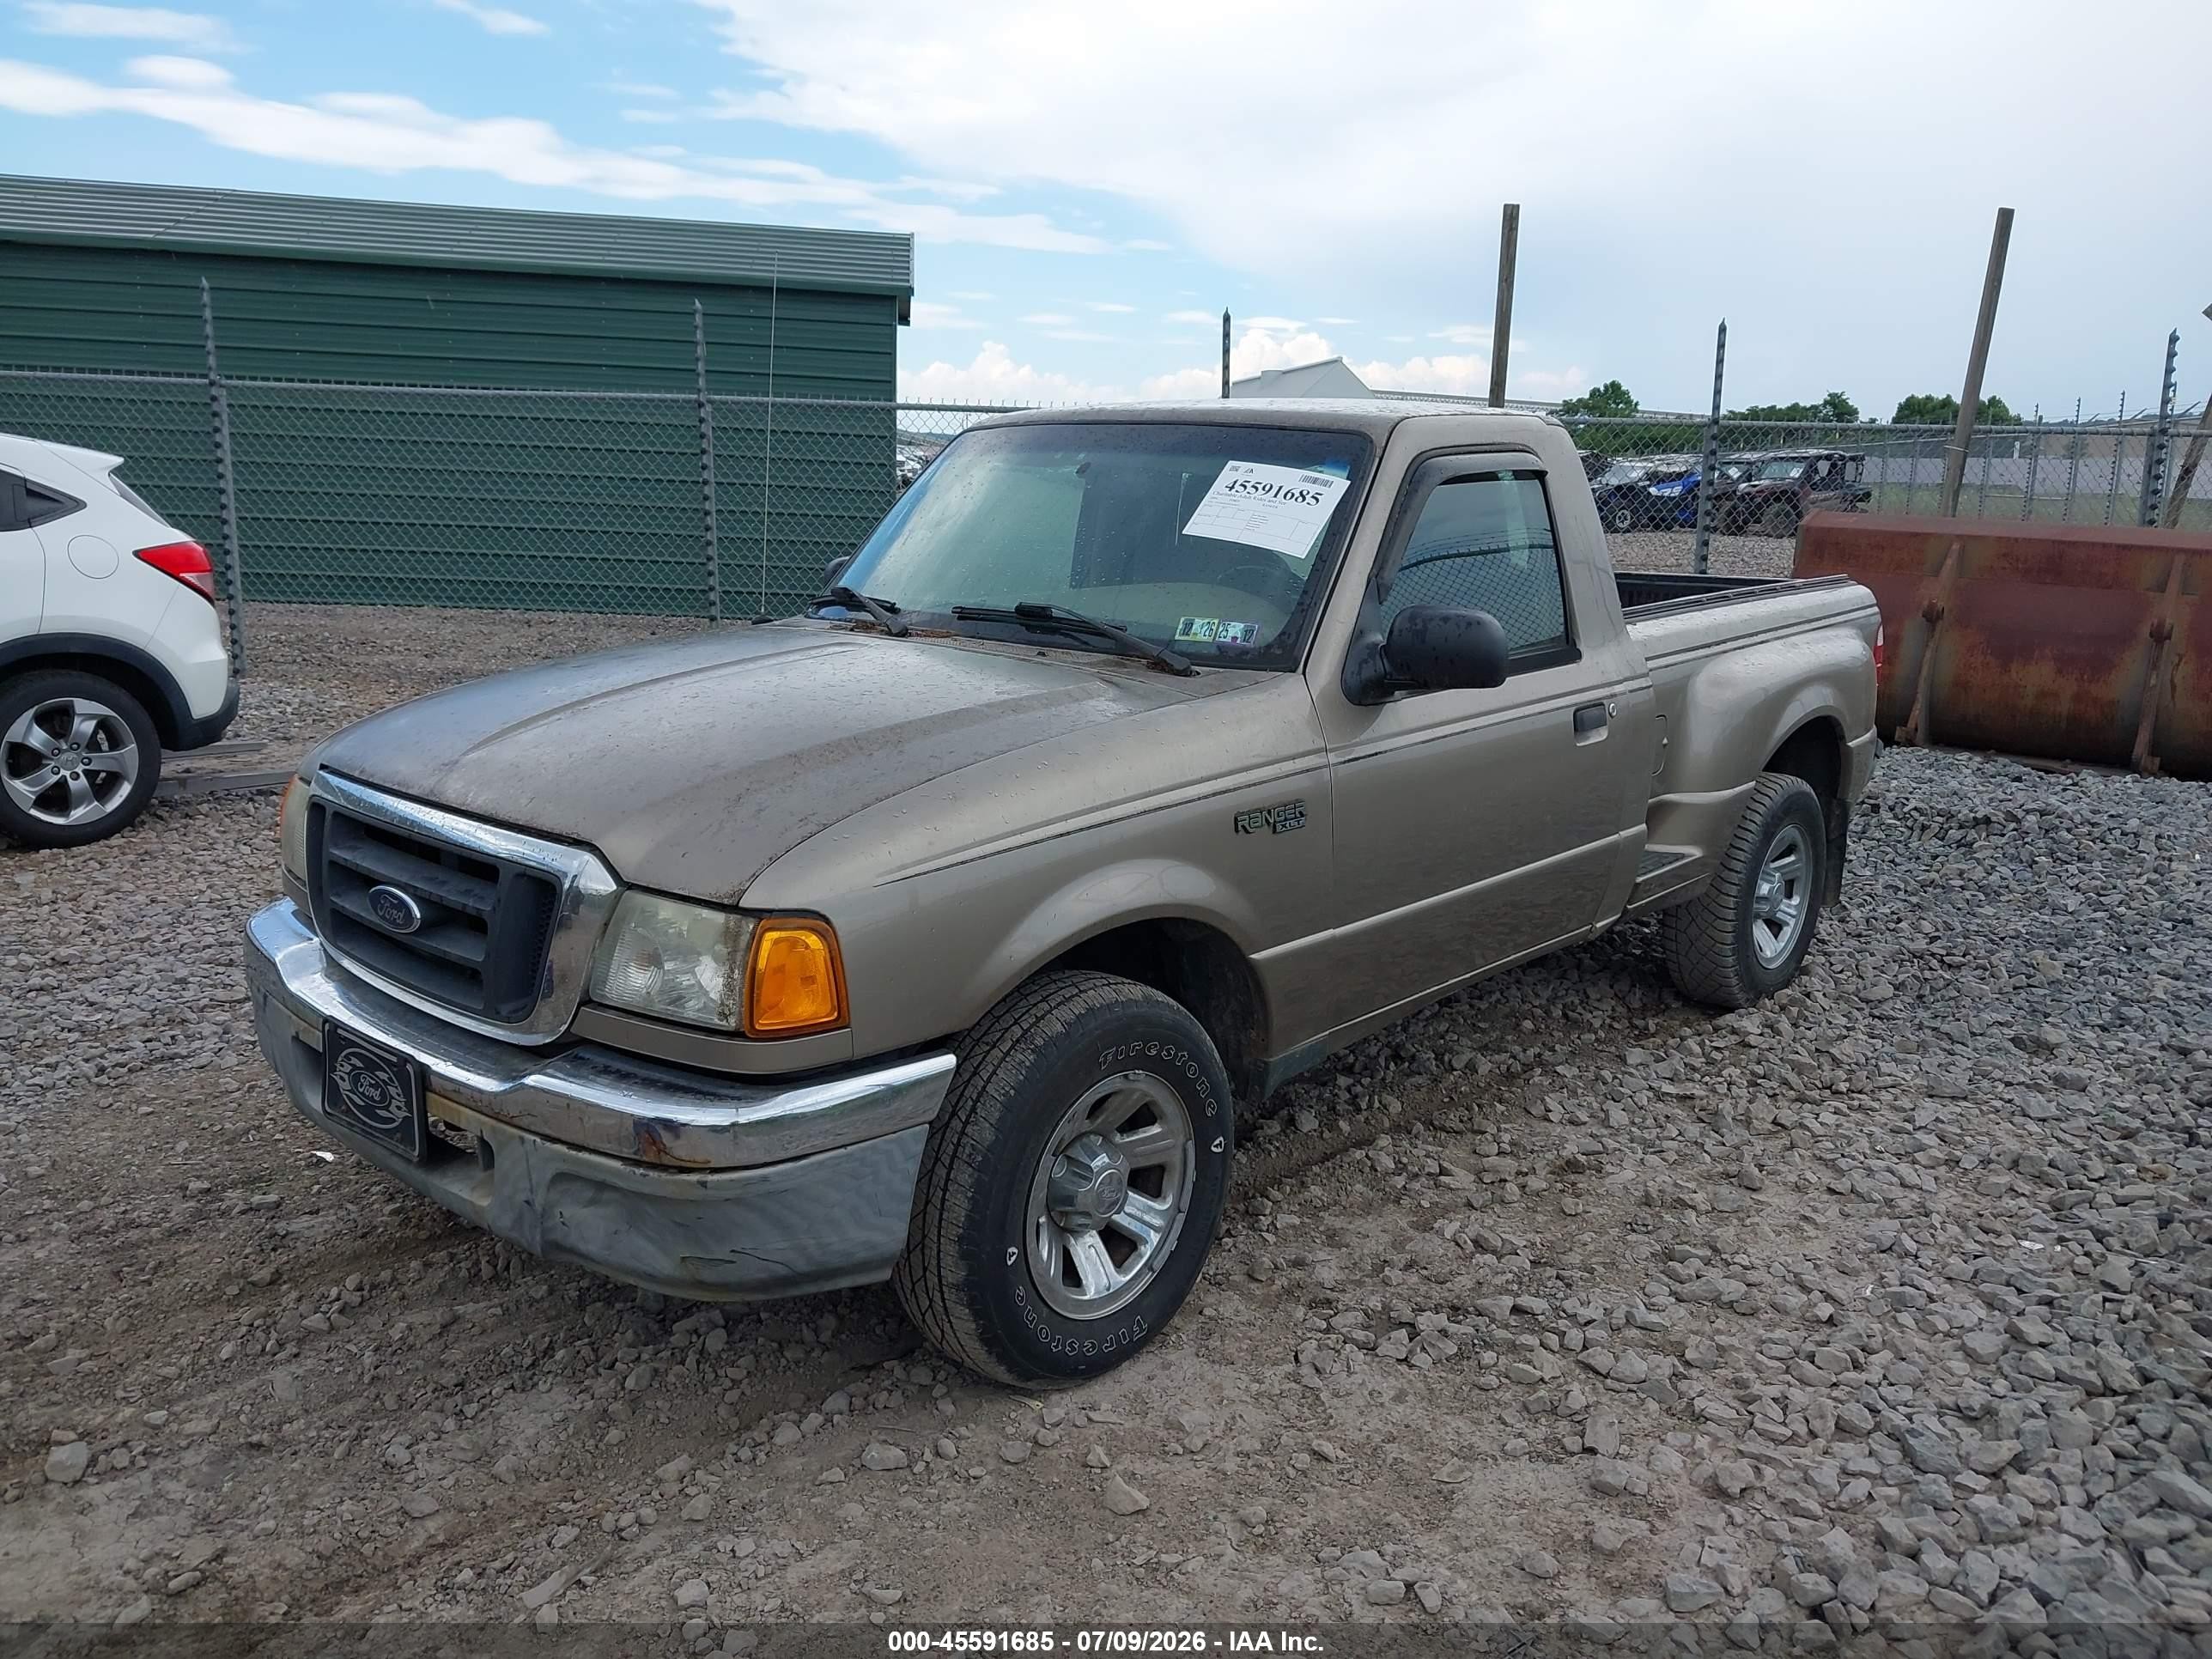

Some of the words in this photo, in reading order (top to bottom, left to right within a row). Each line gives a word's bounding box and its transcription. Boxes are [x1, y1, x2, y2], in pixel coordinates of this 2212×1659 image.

[1224, 478, 1324, 507] 45591685
[1182, 622, 1194, 636] 12
[1218, 623, 1231, 639] 25
[1242, 629, 1255, 644] 12
[1236, 801, 1306, 833] RANGER
[1278, 819, 1304, 830] XLT
[378, 894, 406, 924] Ford
[357, 1073, 381, 1101] Ford
[1098, 1041, 1218, 1117] Firestone
[1014, 1285, 1149, 1356] Firestone
